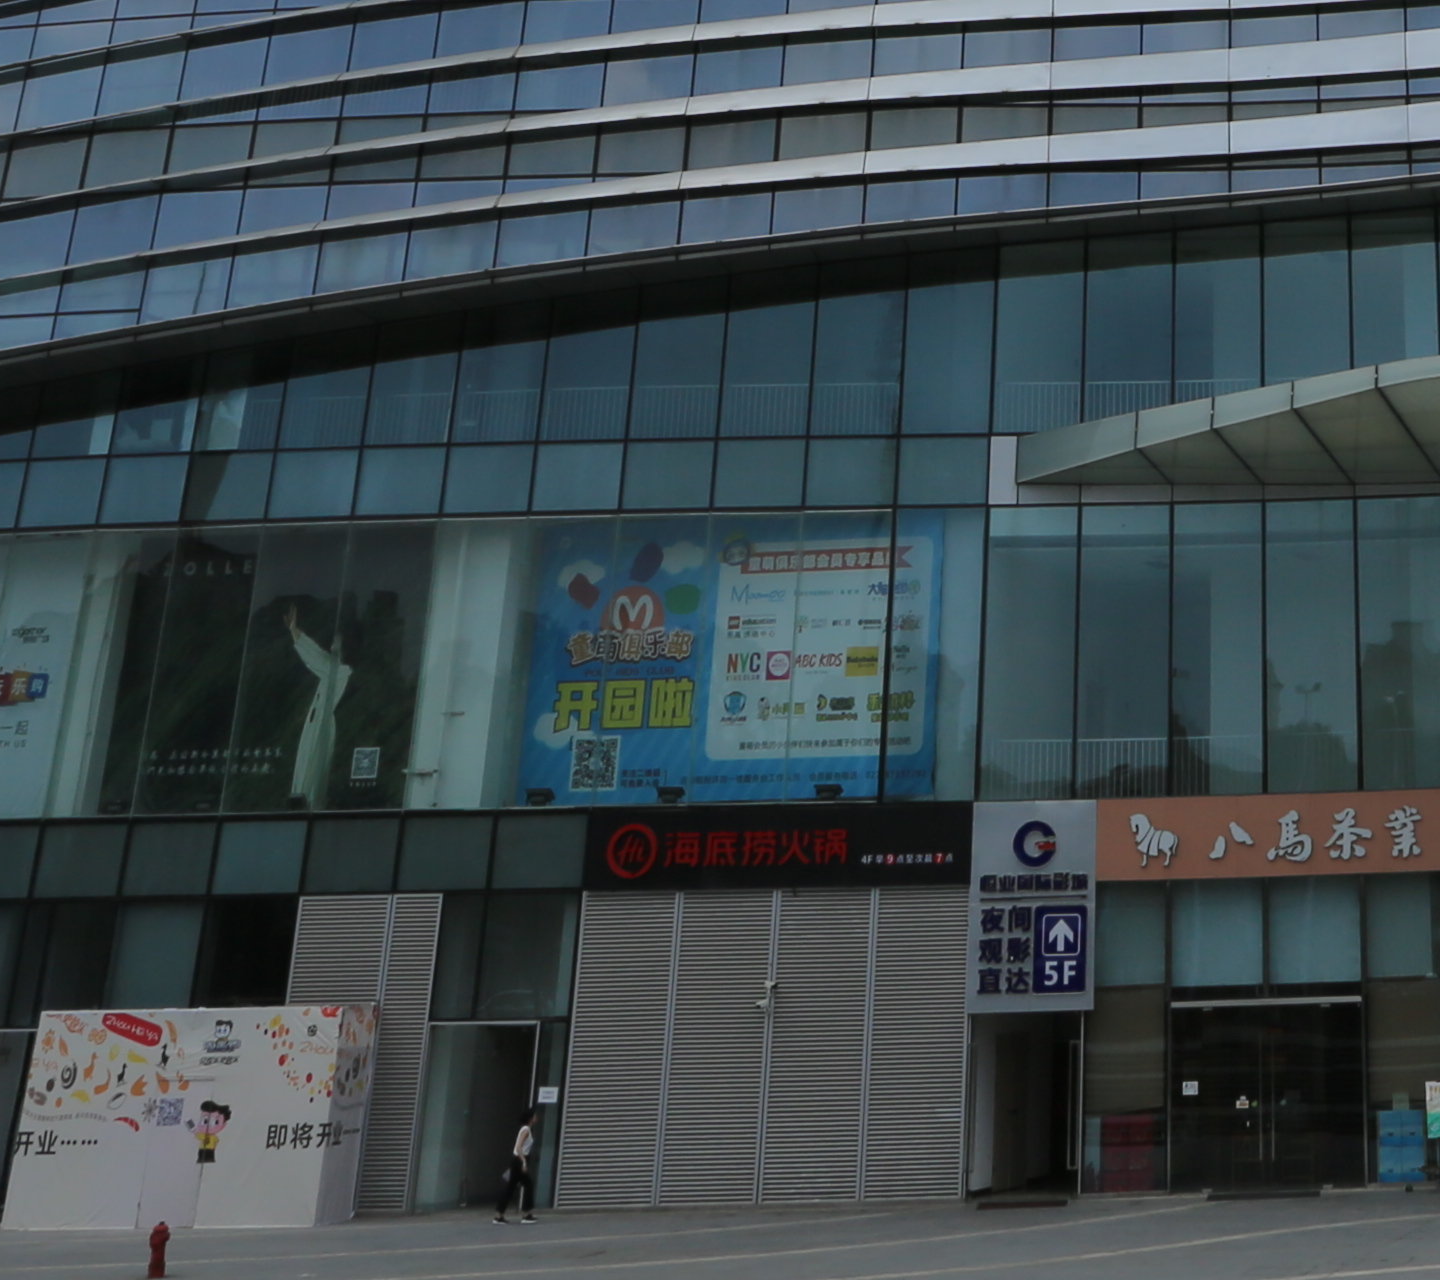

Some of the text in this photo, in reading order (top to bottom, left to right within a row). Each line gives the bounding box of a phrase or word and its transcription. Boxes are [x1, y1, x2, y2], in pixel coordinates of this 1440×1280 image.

[567, 629, 696, 666] 童萌俱乐部
[795, 653, 817, 668] ABC
[819, 652, 843, 668] KIDS
[727, 652, 761, 674] NYC
[553, 677, 696, 733] 开园啦
[663, 828, 849, 868] 海底捞火锅
[979, 872, 1088, 893] 恒业国际影城
[980, 905, 1032, 934] 夜间
[978, 937, 1031, 964] 观影
[977, 967, 1030, 995] 直达
[1043, 959, 1077, 986] 5F
